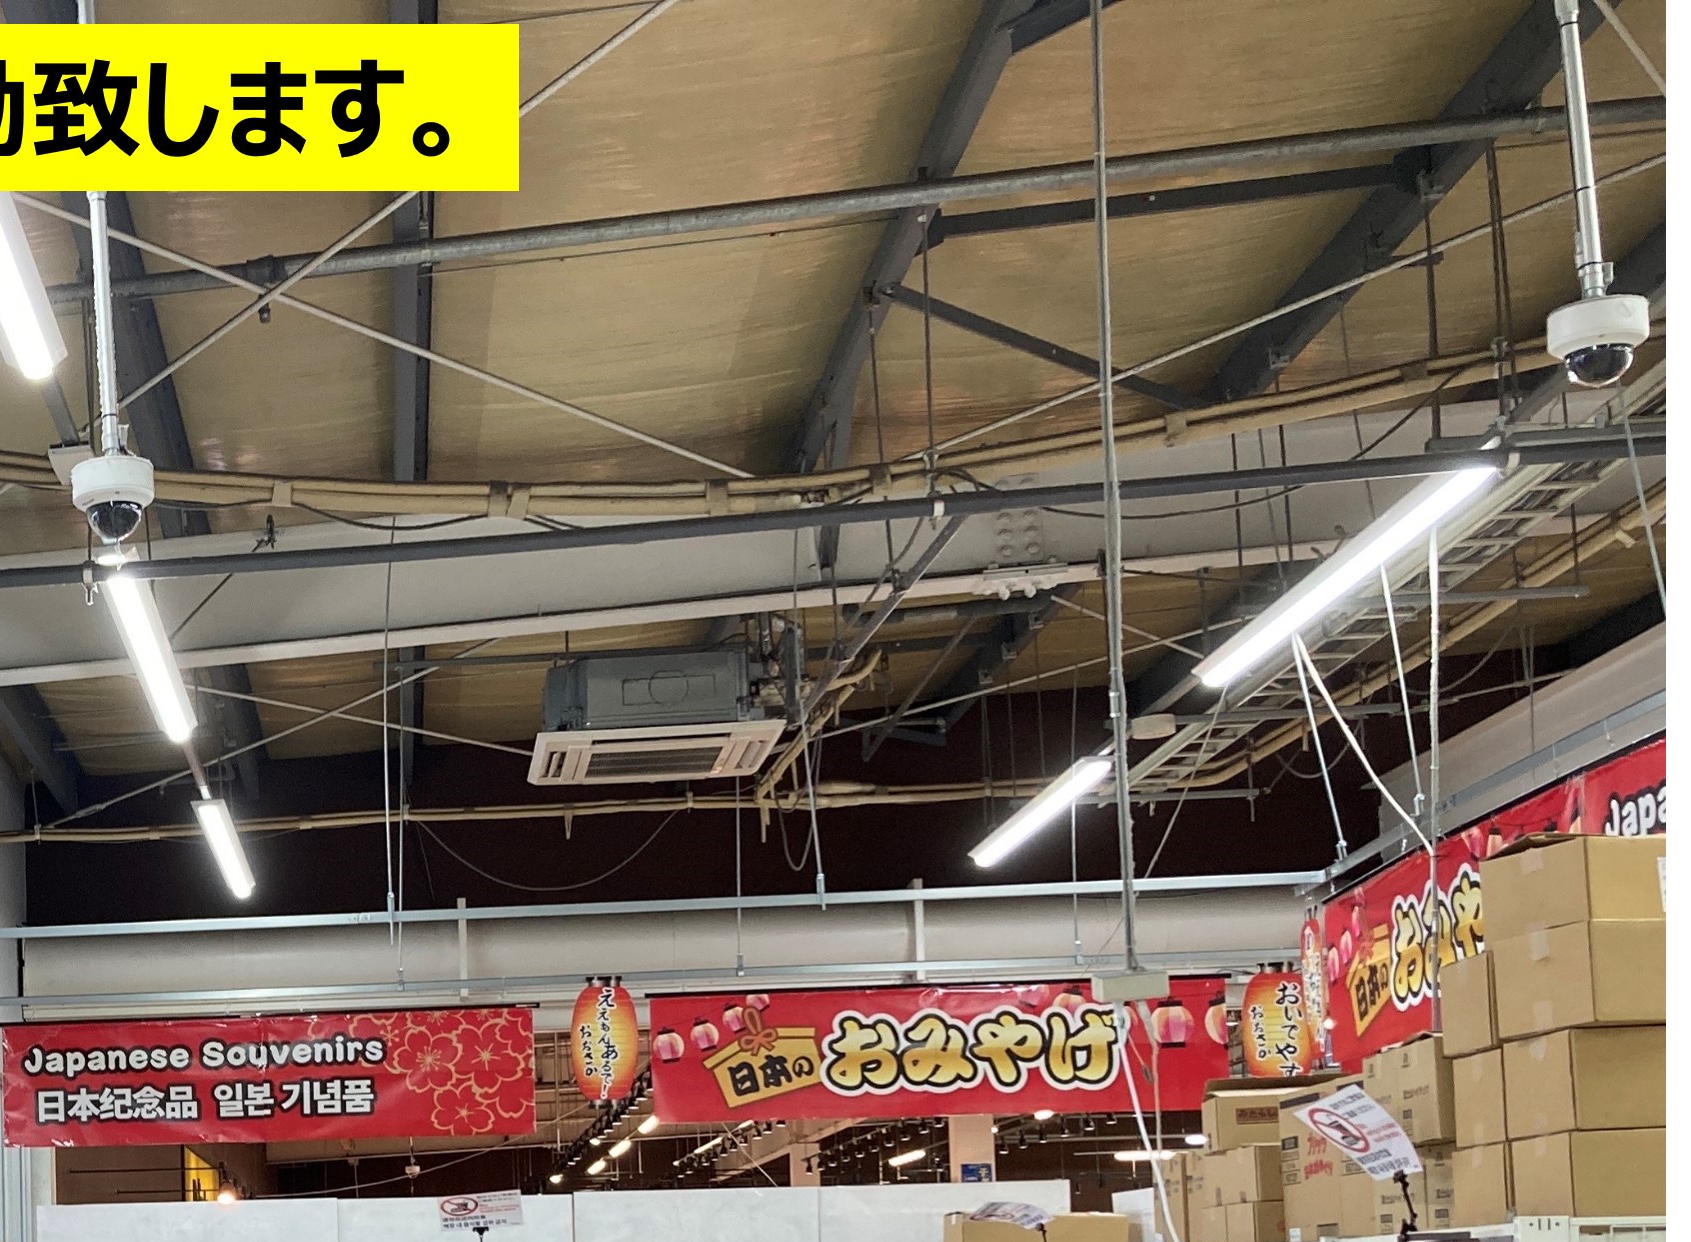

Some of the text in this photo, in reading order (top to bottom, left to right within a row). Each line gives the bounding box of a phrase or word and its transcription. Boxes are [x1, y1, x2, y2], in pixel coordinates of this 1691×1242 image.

[1356, 960, 1390, 1022] 日本の
[24, 1034, 385, 1078] Japanese Souvenirs
[579, 1024, 597, 1077] おおさか
[728, 1009, 1117, 1098] 日本の おみやげ
[36, 1086, 198, 1123] 日本纪念品
[213, 1078, 375, 1118] 일본 기념품
